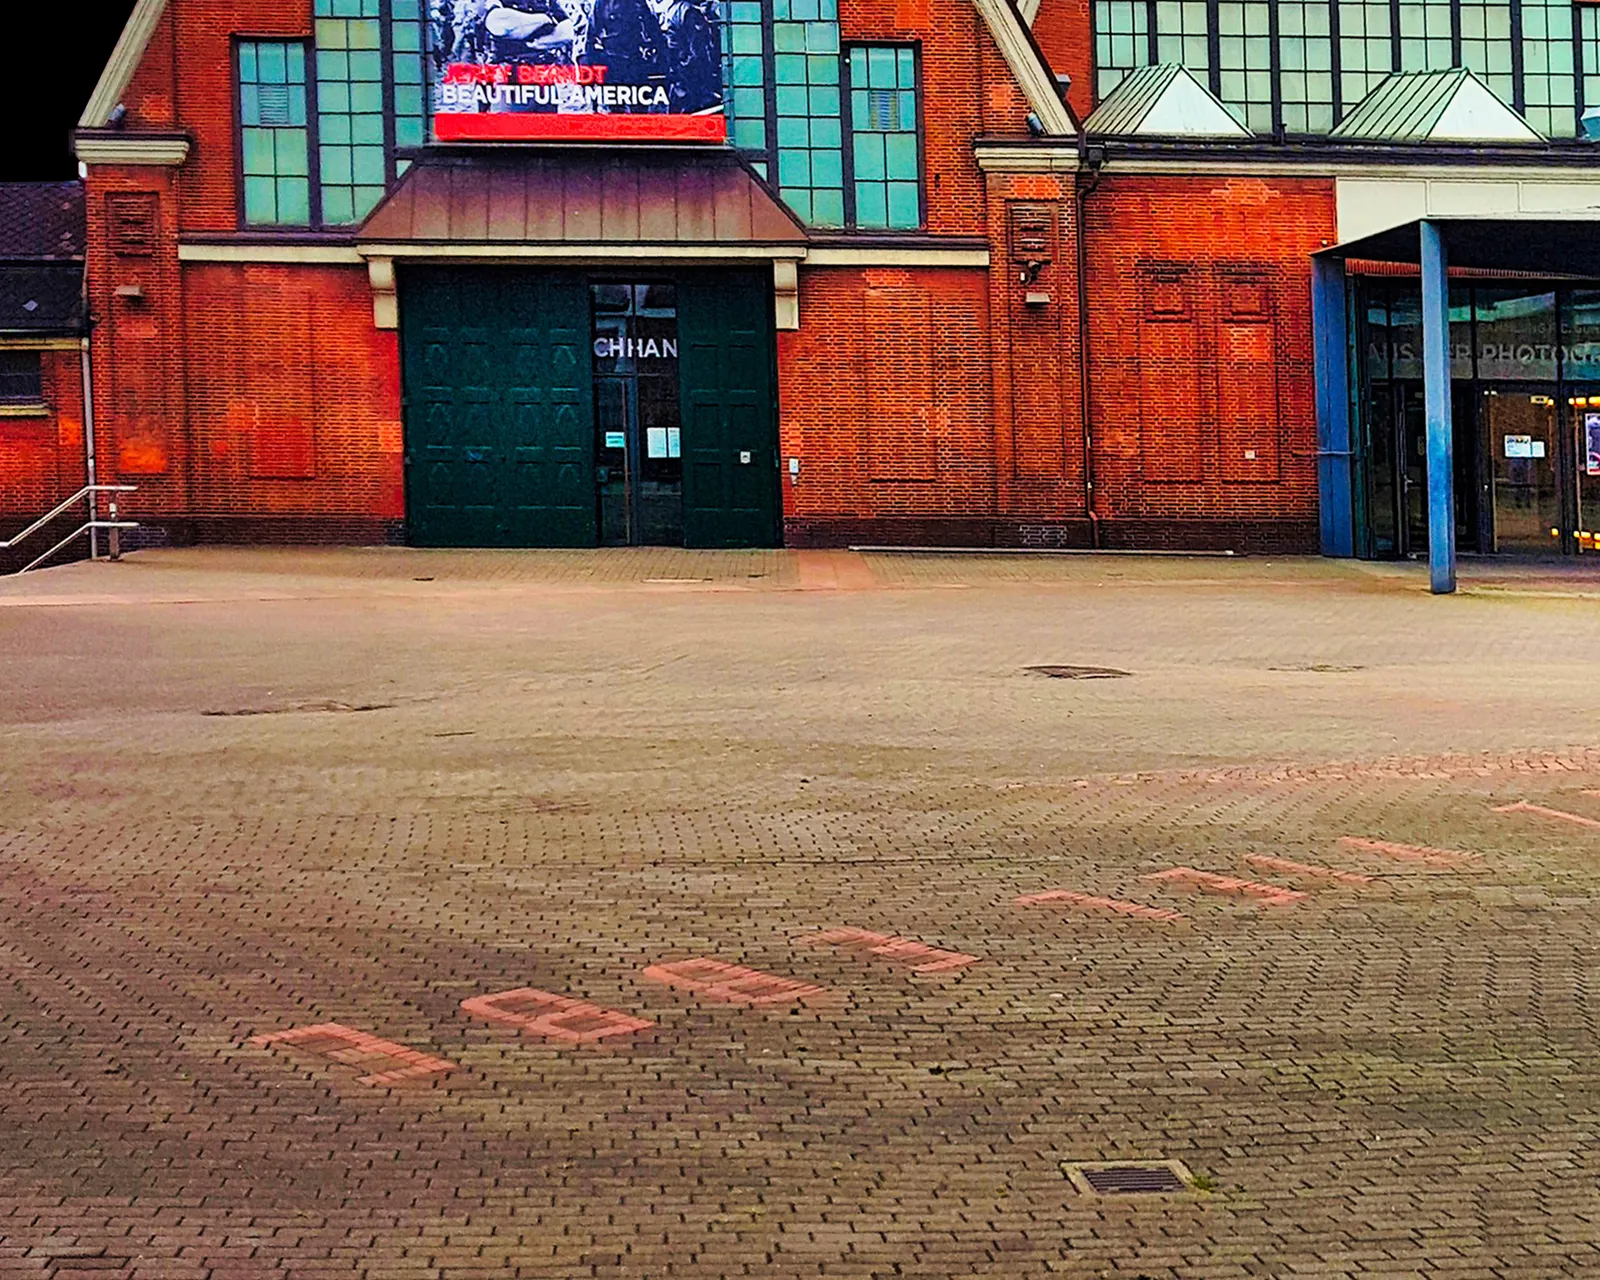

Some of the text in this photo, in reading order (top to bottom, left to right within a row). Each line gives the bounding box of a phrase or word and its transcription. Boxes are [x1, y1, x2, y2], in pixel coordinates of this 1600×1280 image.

[442, 84, 671, 106] BEAUTIFUL AMERICA
[594, 337, 678, 359] CHHAN
